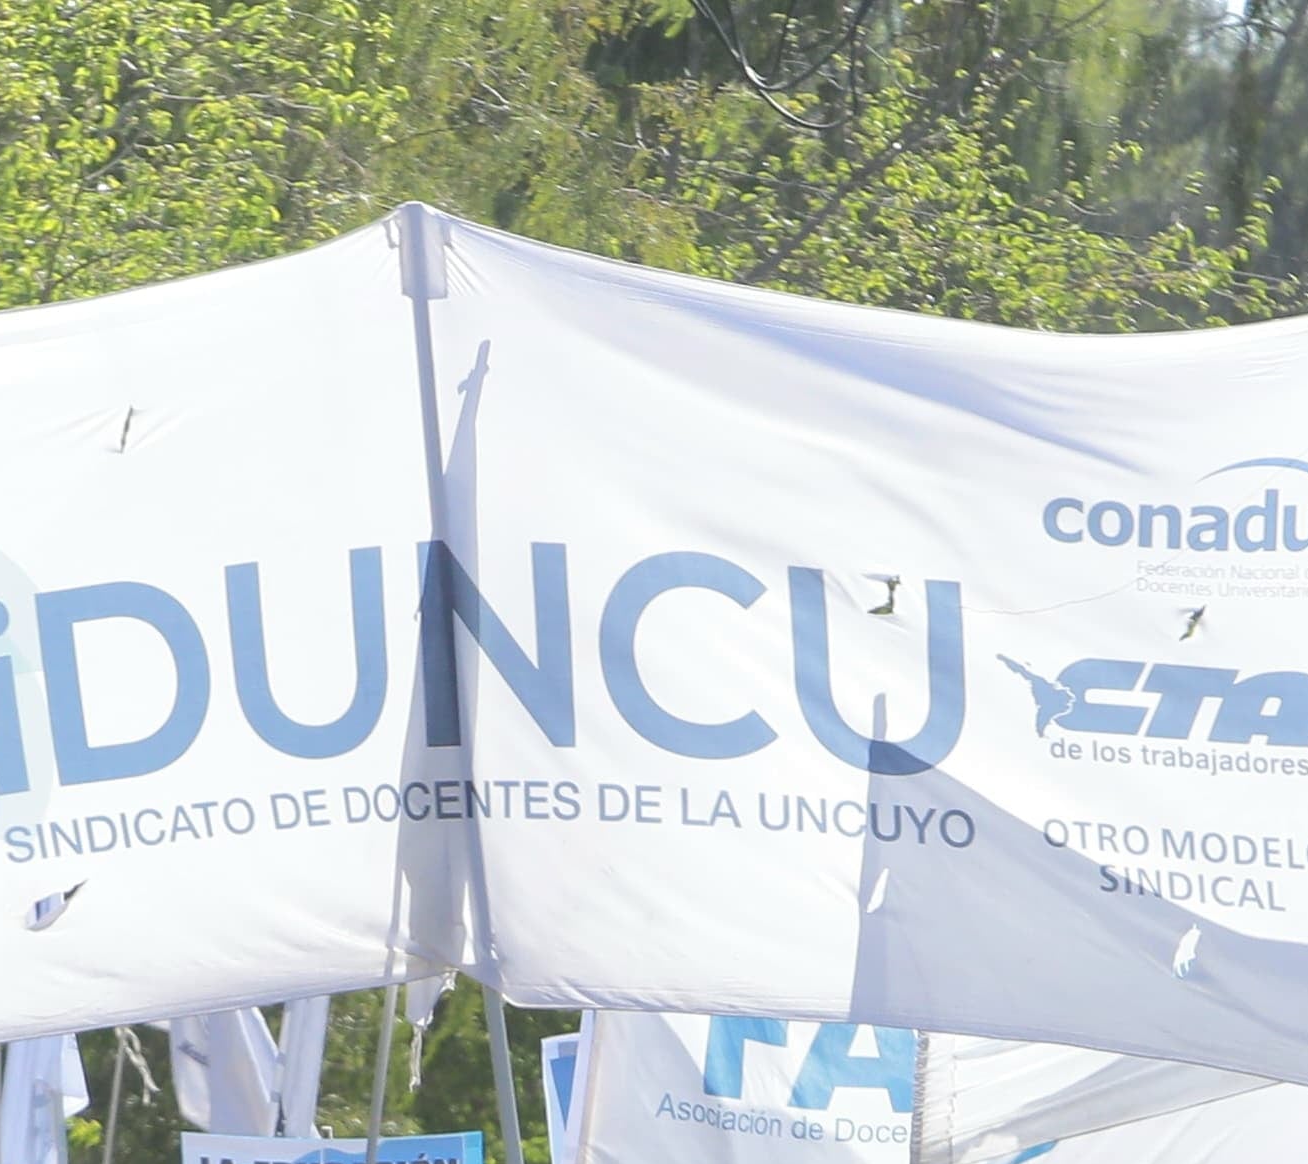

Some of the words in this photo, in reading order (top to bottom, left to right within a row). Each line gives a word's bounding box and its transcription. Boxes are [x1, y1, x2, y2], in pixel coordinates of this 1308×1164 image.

[1049, 737, 1082, 761] de
[1092, 741, 1132, 766] los
[5, 800, 257, 866] SINDICATO
[270, 787, 331, 829] DE
[343, 779, 581, 824] DOCENTES
[598, 783, 666, 824] DE
[680, 787, 742, 830] LA
[759, 791, 977, 849] UNCUYO
[1043, 818, 1151, 857] OTRO
[1099, 865, 1287, 913] SINDICAL
[655, 1092, 783, 1138] Asociación
[790, 1114, 824, 1143] de
